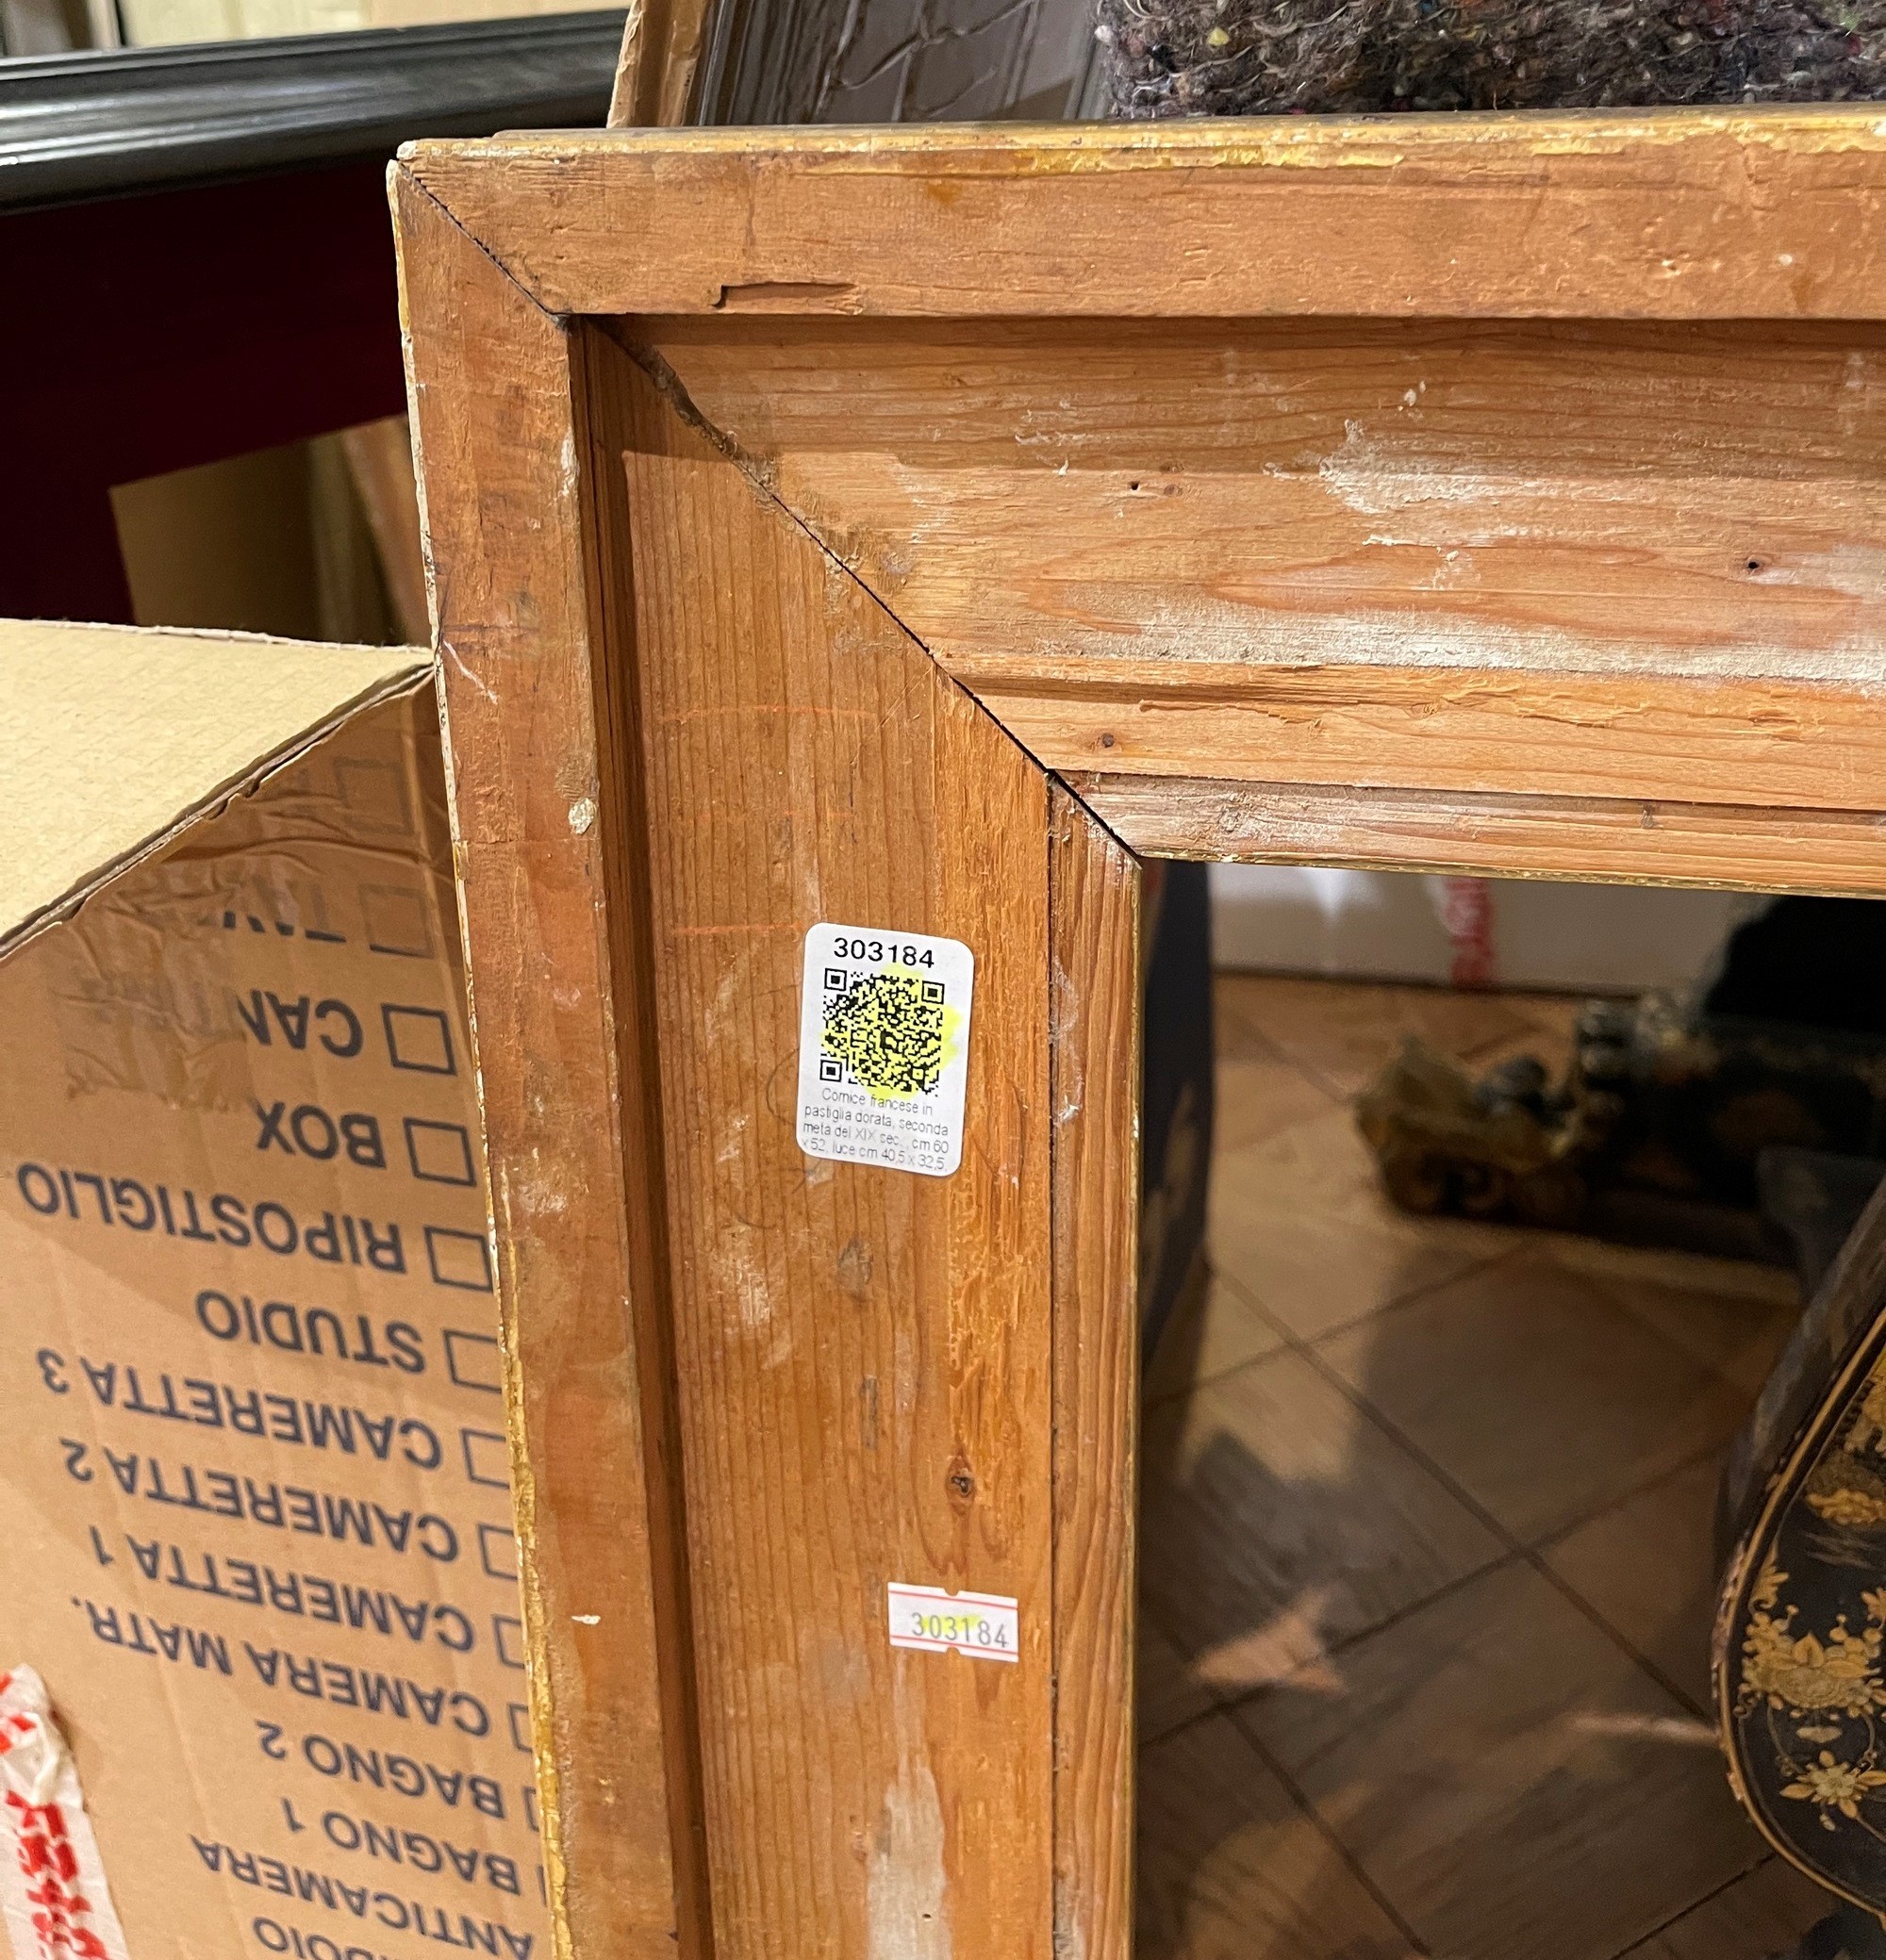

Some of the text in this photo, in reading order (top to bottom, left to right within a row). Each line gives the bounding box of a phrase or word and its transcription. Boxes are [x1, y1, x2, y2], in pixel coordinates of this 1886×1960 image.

[834, 937, 935, 968] 303184
[256, 1101, 386, 1169] BOX
[804, 1106, 852, 1123] pastiglia
[900, 1119, 949, 1136] seconda
[822, 1088, 933, 1115] Cornice francese in
[835, 1126, 851, 1139] del
[855, 1128, 877, 1142] XIX
[912, 1139, 931, 1150] cm
[934, 1140, 949, 1153] 60
[833, 1141, 855, 1155] luce
[860, 1147, 877, 1159] cm
[908, 1155, 915, 1165] x
[17, 1163, 407, 1274] RIPOSTIGLIO
[196, 1290, 426, 1373] STUDIO
[35, 1349, 442, 1469] CAMERETTA 3
[58, 1438, 459, 1561] CAMERETTA 2
[90, 1525, 473, 1652] CAMERETTA 1
[911, 1612, 1009, 1648] 303184
[71, 1596, 488, 1738] CAMERA MATR.
[256, 1719, 505, 1819] BAGNO 2
[282, 1798, 520, 1894] BAGNO 1
[190, 1834, 533, 1960] ANTICAMERA
